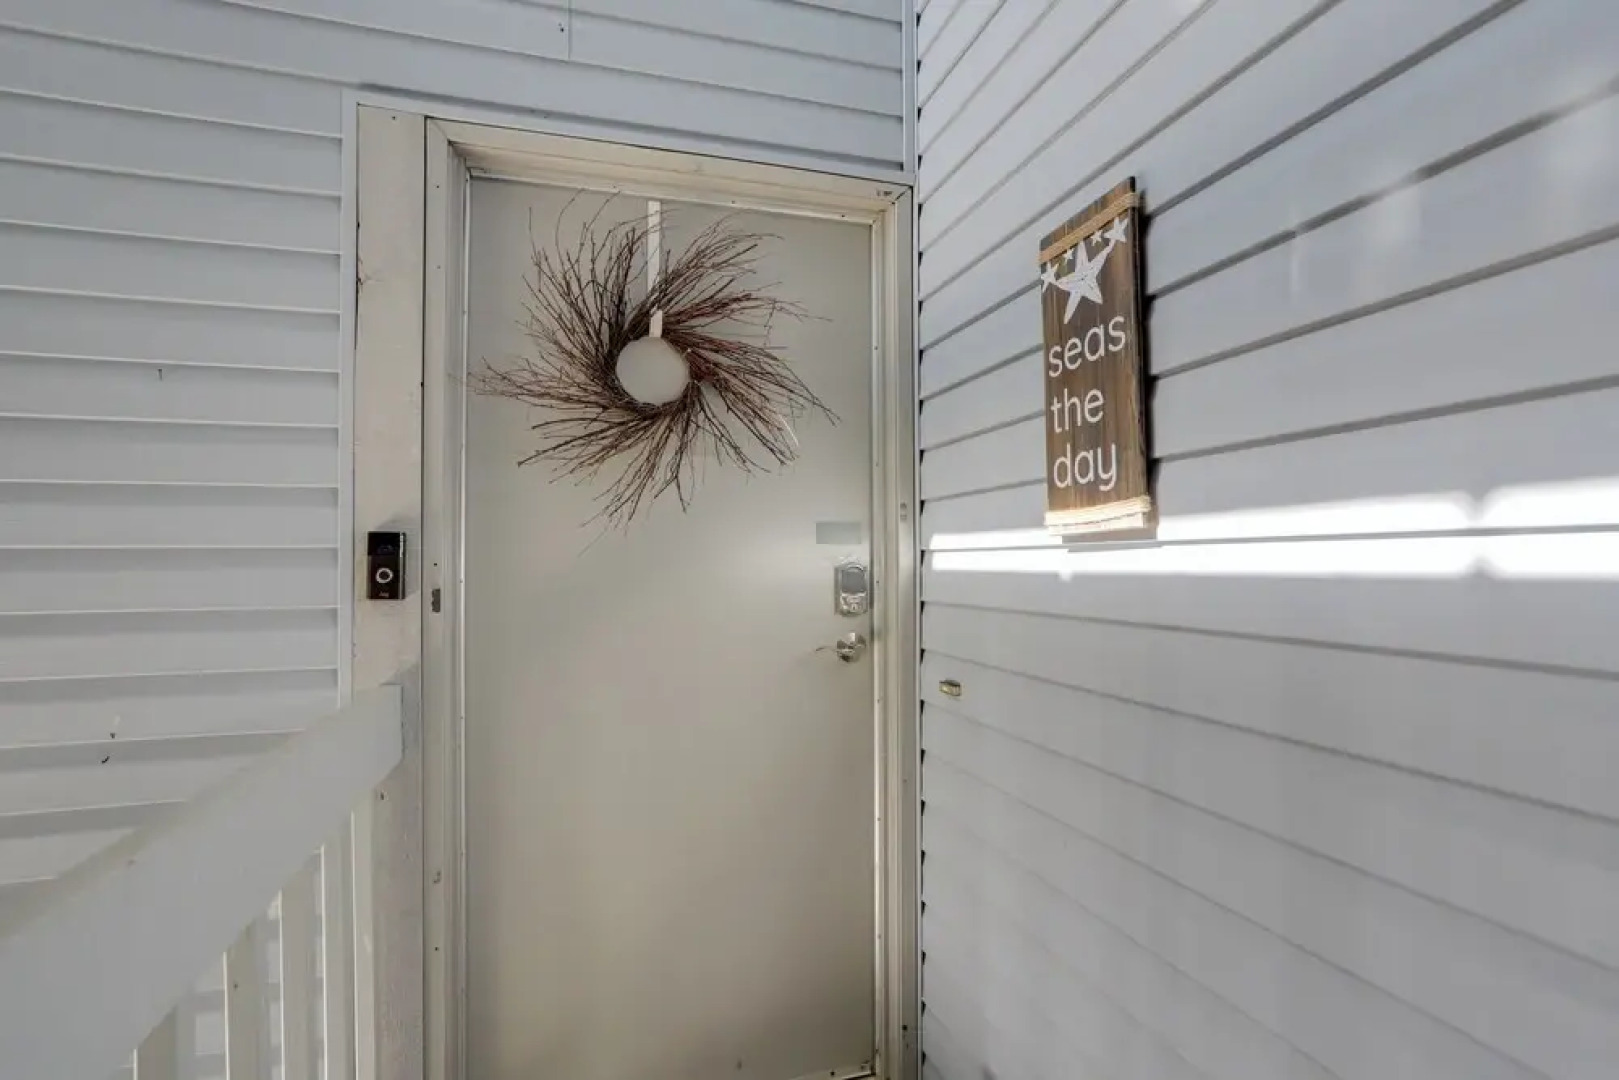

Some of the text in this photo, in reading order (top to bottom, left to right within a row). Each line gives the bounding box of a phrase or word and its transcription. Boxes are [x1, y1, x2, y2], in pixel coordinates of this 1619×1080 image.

[1048, 315, 1126, 378] seas
[1050, 388, 1105, 433] the
[1053, 442, 1117, 492] day
